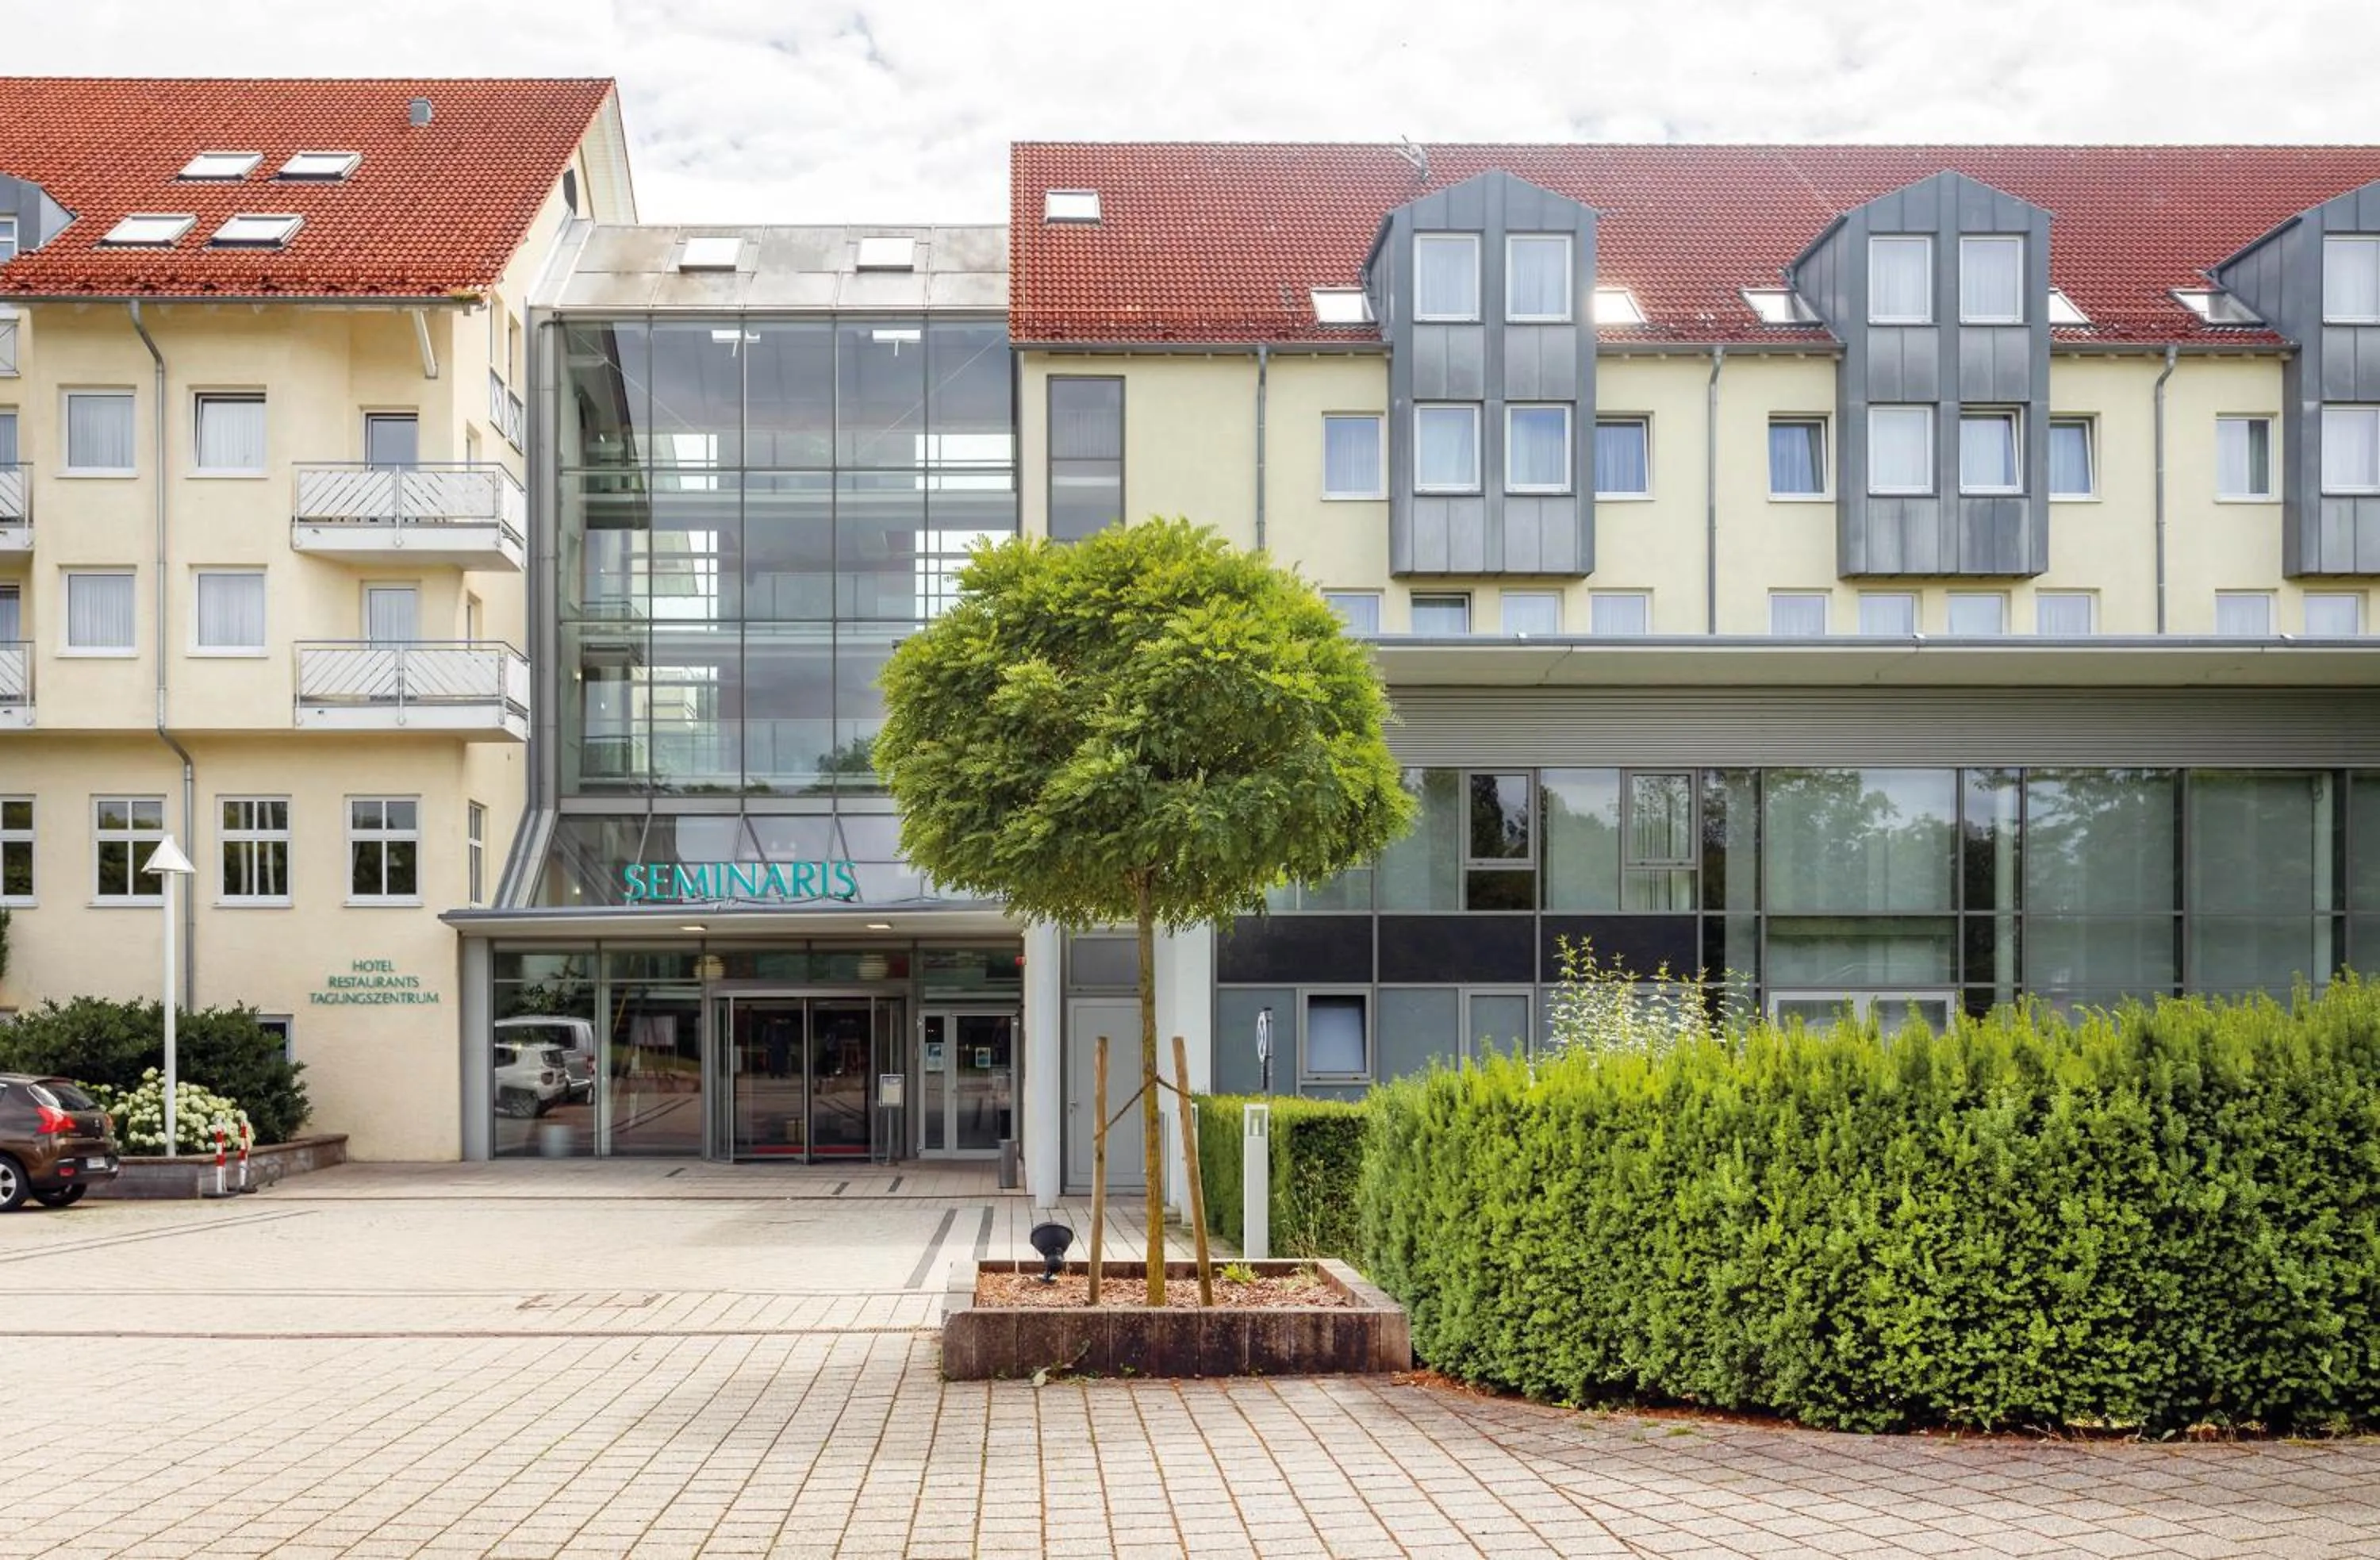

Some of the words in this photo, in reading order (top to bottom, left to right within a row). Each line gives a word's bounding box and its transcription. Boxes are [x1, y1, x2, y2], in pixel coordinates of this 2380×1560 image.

[623, 862, 858, 900] SEMINARIS
[352, 959, 395, 972] HOTEL
[328, 976, 420, 988] RESTAURANTS
[309, 992, 440, 1005] TAGUNGSZENTRUM
